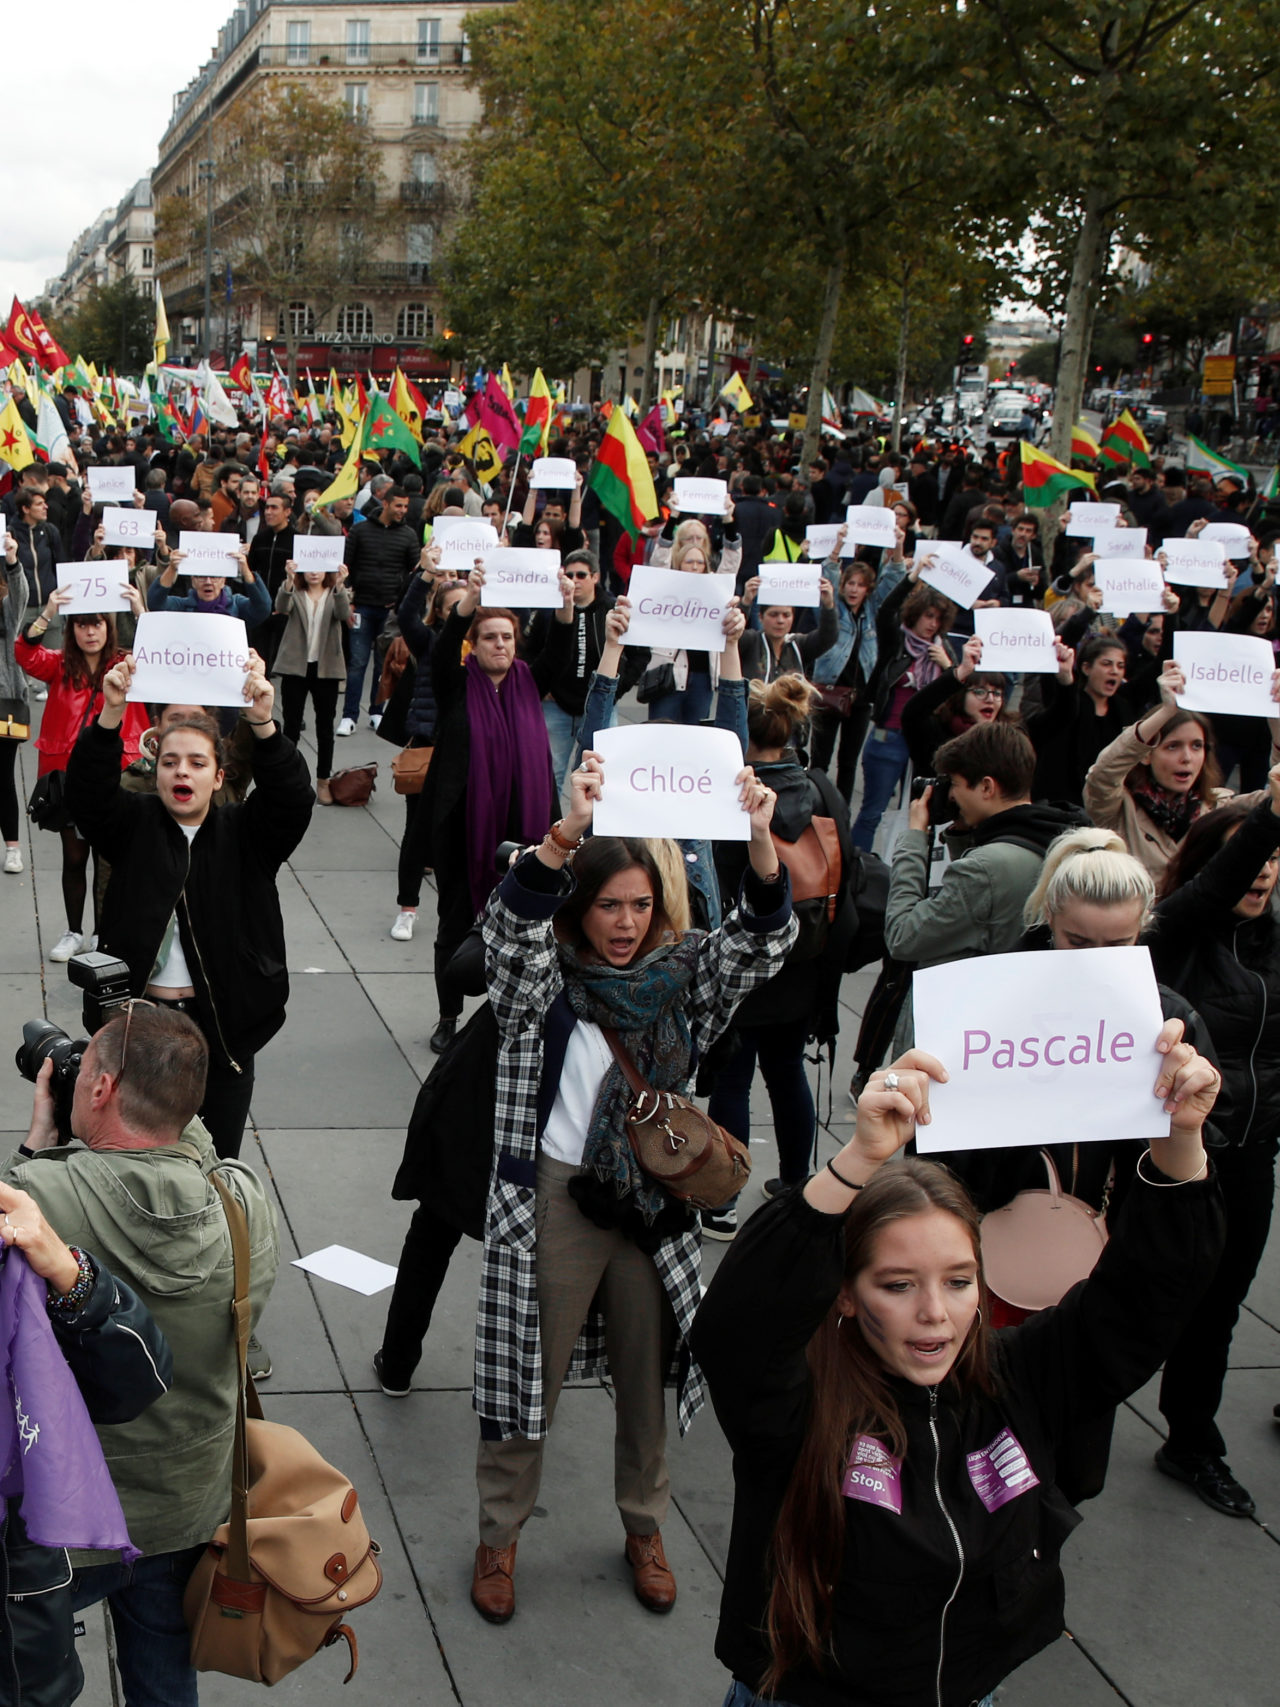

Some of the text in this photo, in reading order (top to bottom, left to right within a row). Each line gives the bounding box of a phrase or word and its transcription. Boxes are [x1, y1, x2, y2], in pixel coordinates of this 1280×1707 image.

[314, 332, 395, 344] PIZZA PINO
[98, 479, 125, 490] Janice
[119, 521, 138, 536] 63
[855, 519, 889, 531] Sandra
[445, 539, 493, 551] Michèle
[300, 548, 338, 559] Nathalie
[497, 569, 549, 584] Sandra
[940, 561, 972, 587] Gaëlle
[80, 578, 107, 597] 75
[769, 577, 811, 590] Ginette
[1106, 578, 1158, 591] Nathalie
[639, 597, 721, 621] Caroline
[988, 630, 1047, 648] Chantal
[133, 646, 245, 669] Antoinette
[576, 665, 586, 678] YOU
[1190, 662, 1264, 685] Isabelle
[629, 765, 713, 795] Chloé
[962, 1019, 1135, 1071] Pascale
[850, 1471, 886, 1492] Stop.
